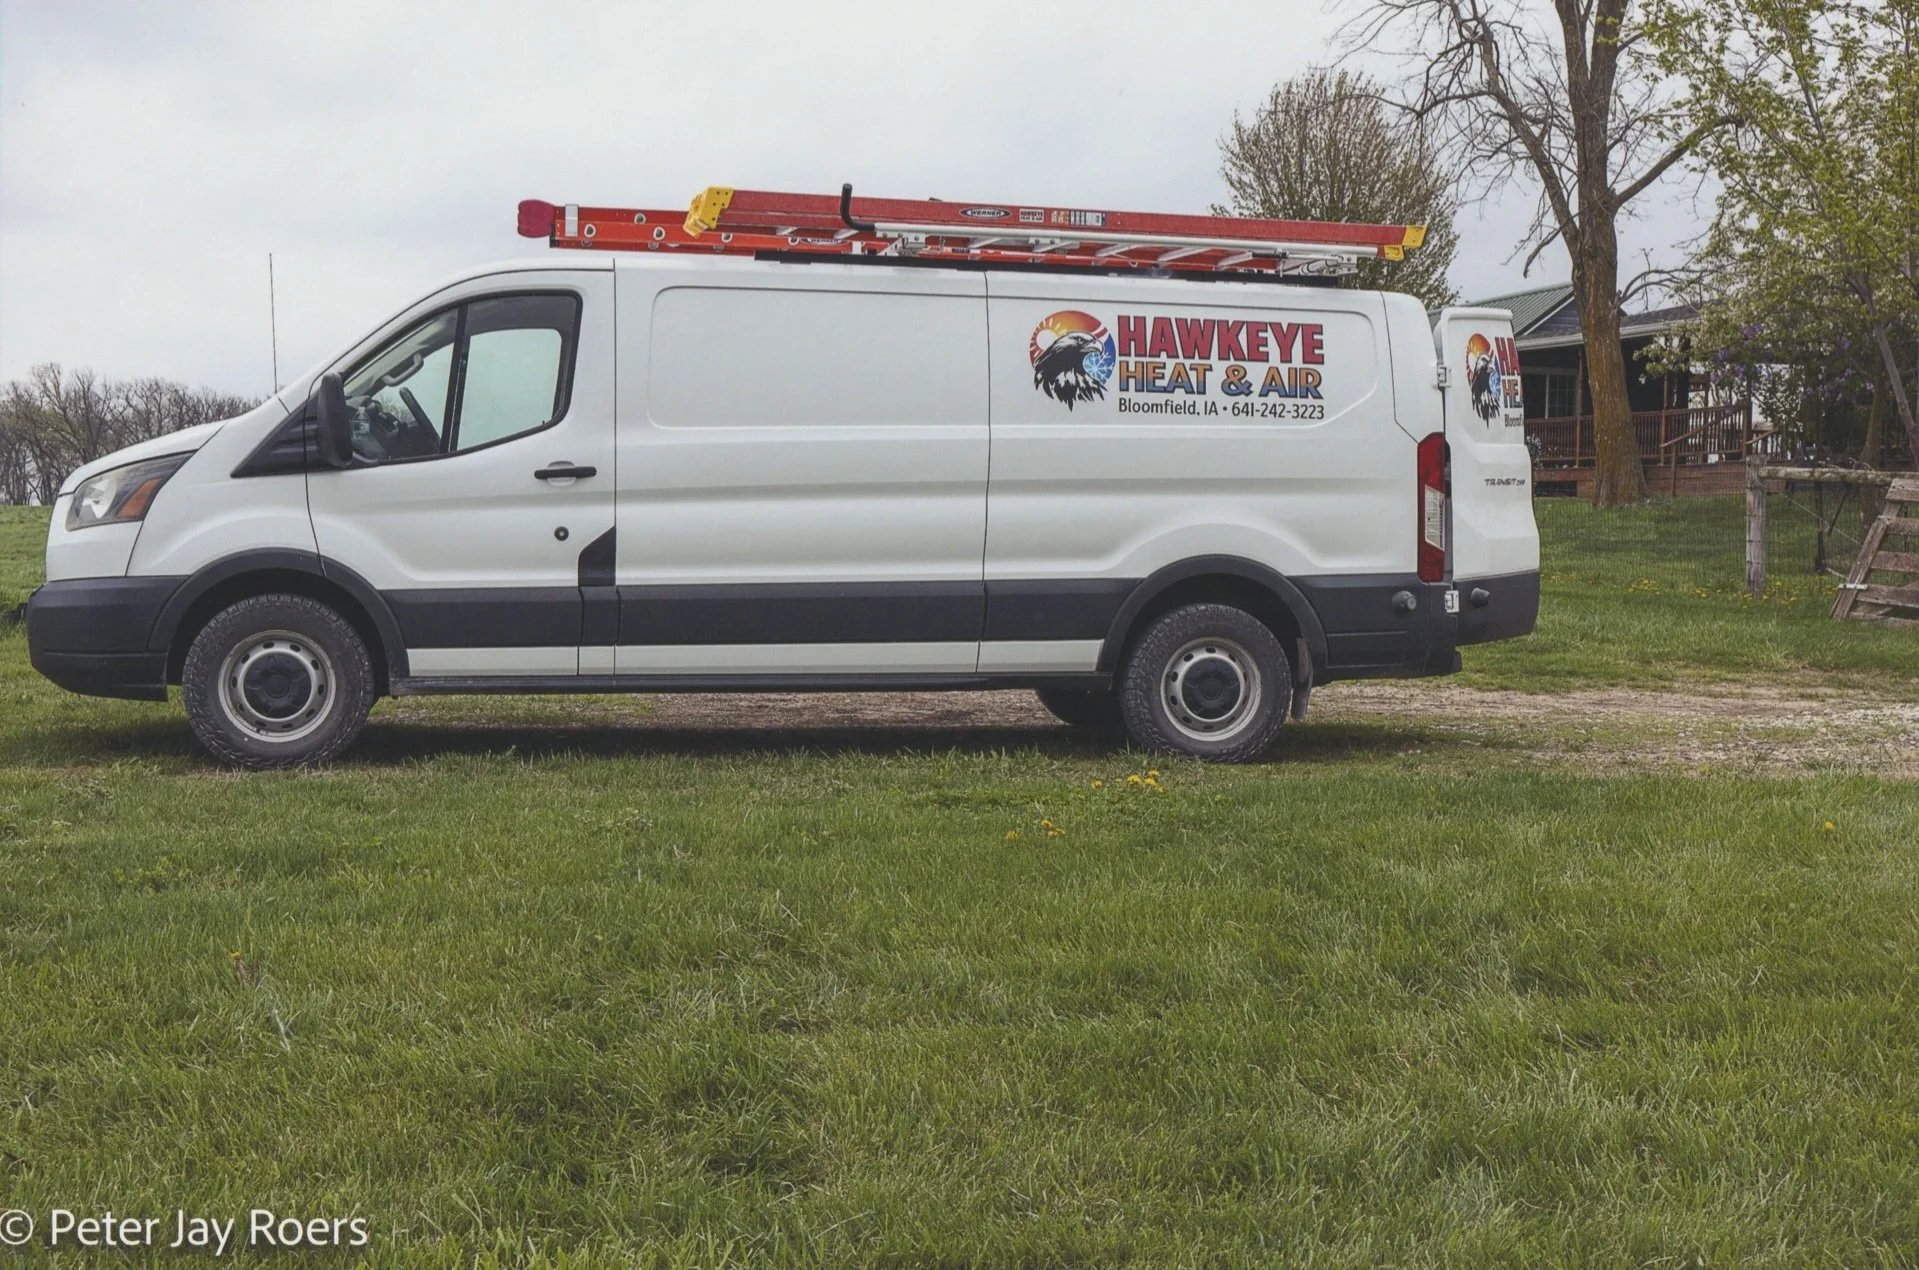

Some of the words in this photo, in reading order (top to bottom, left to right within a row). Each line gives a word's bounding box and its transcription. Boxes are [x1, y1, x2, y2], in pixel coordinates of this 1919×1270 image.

[1117, 315, 1325, 365] HAWKEYE
[1118, 360, 1213, 395] HEAT
[1221, 363, 1254, 398] &
[1258, 366, 1324, 400] AIR
[1501, 379, 1524, 408] HE
[1118, 397, 1200, 416] Bloomfield,
[1204, 401, 1218, 416] IA
[1231, 402, 1325, 420] 641-242-3223
[1484, 477, 1516, 487] TRANSIT
